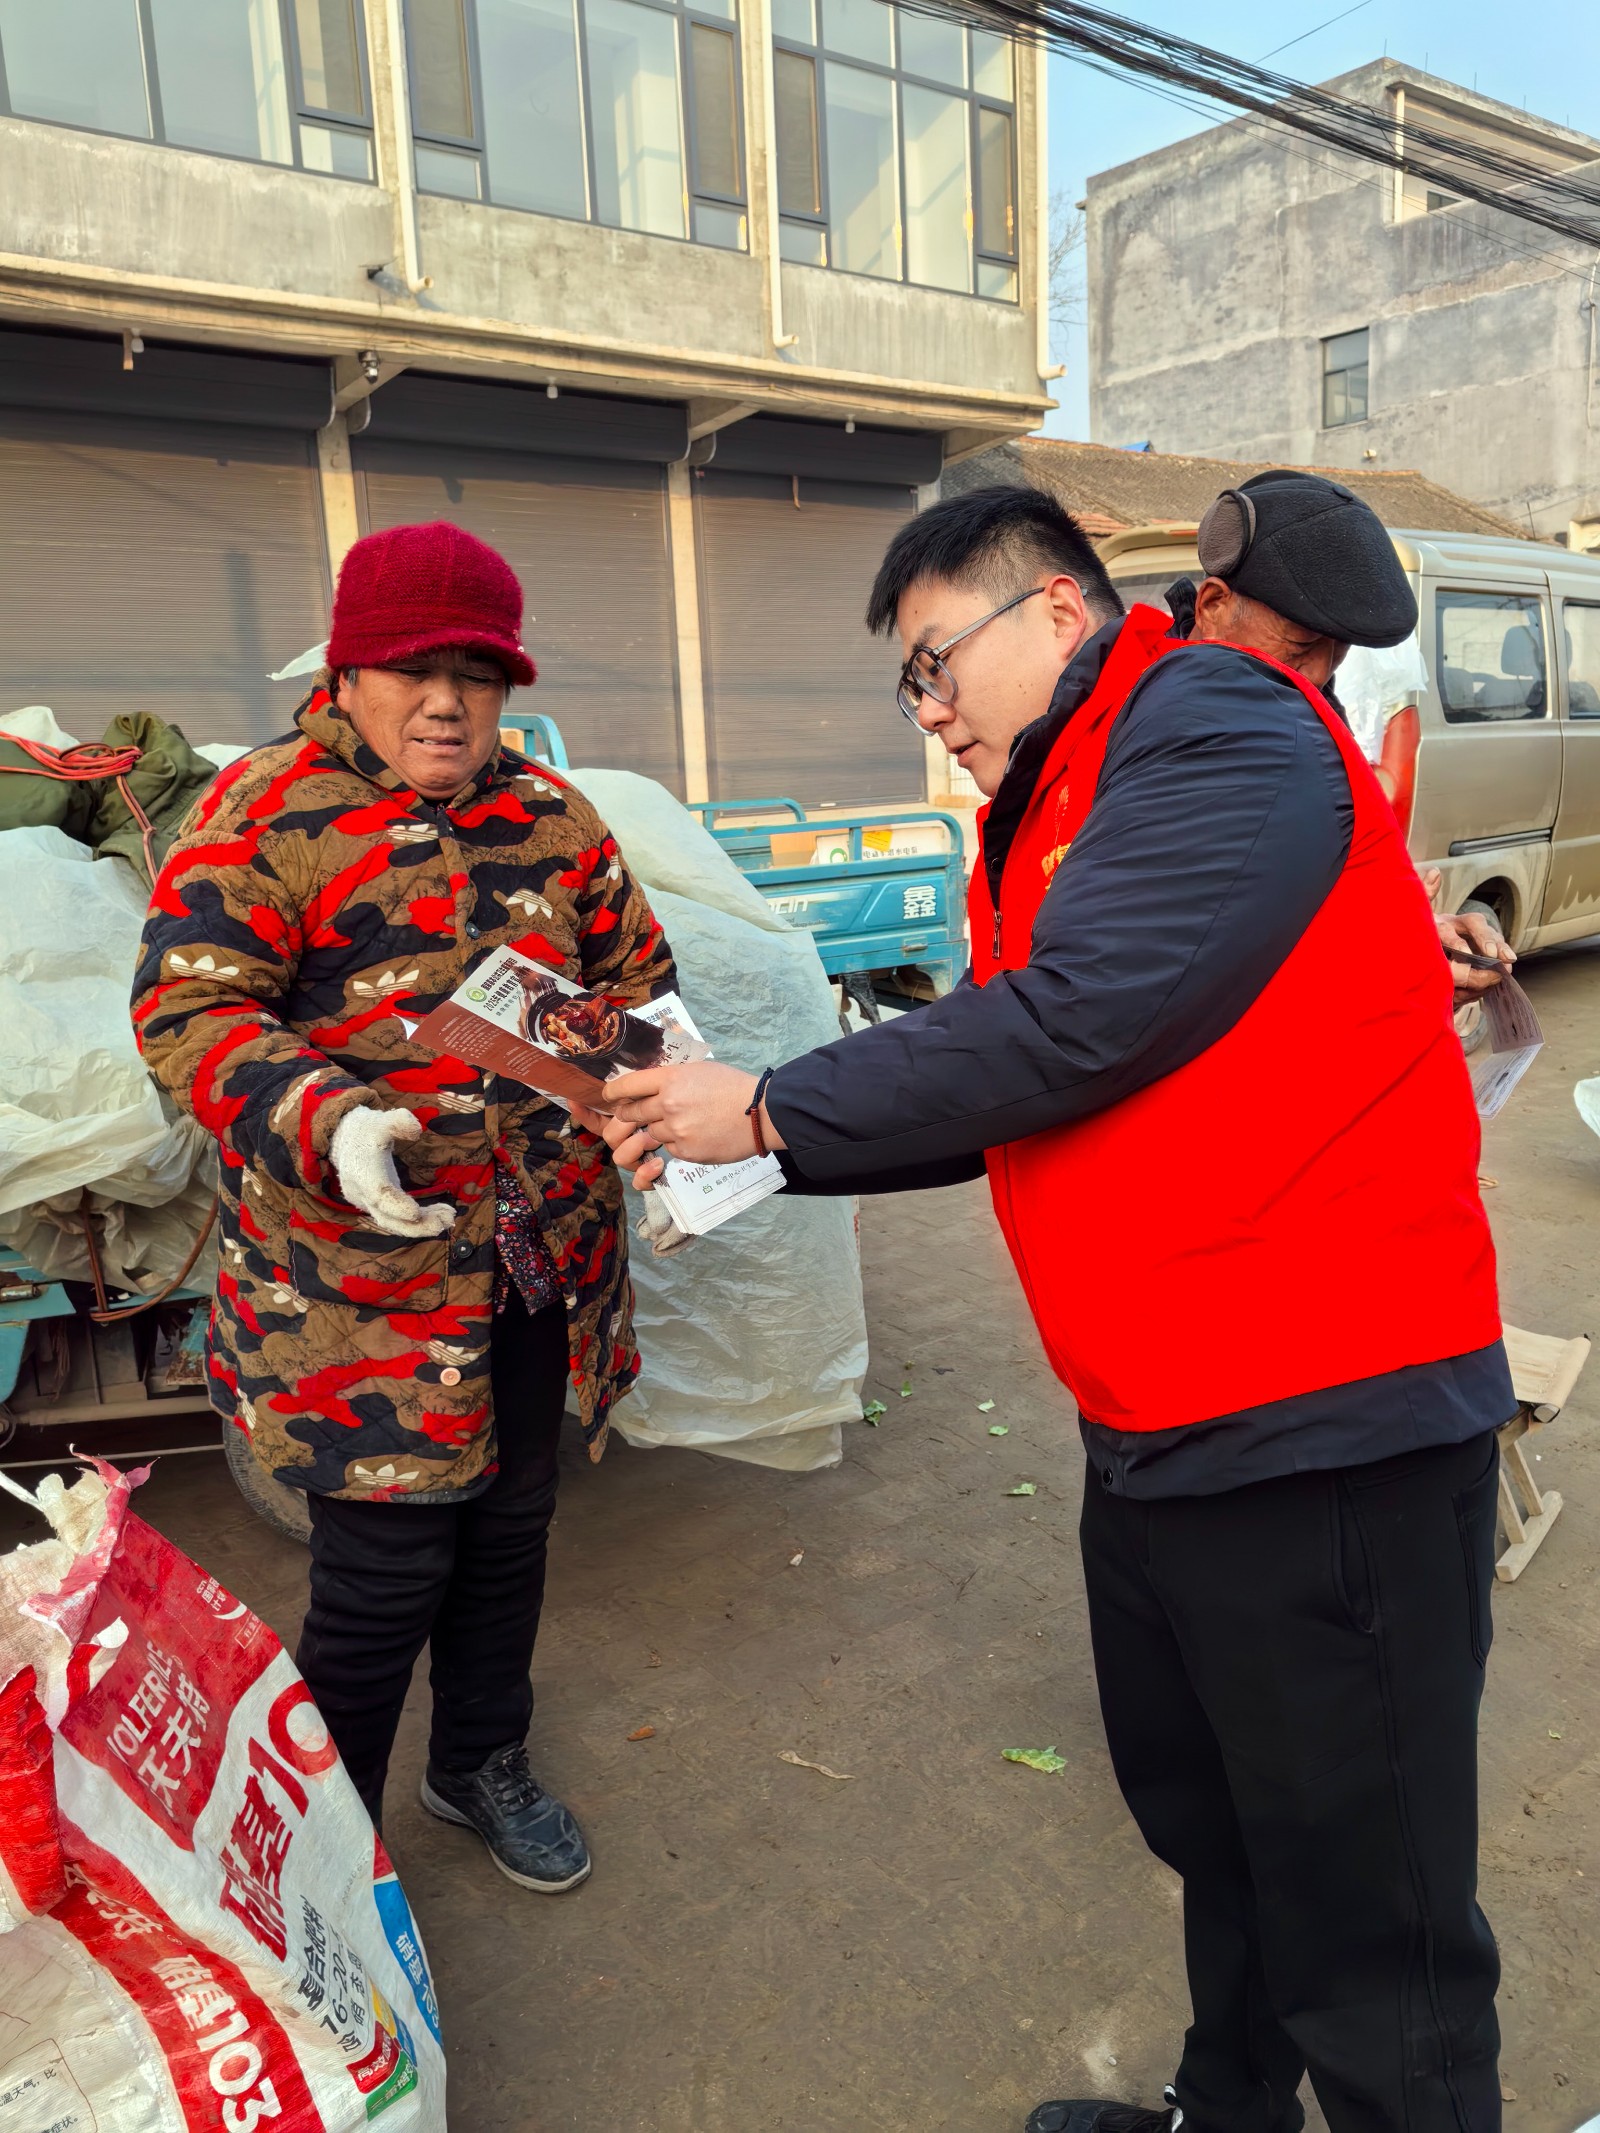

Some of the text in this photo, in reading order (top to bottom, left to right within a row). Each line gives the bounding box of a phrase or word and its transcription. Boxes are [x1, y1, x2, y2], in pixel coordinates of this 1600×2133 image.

[903, 885, 937, 920] 鑫
[298, 1895, 327, 2011] 复合肥料
